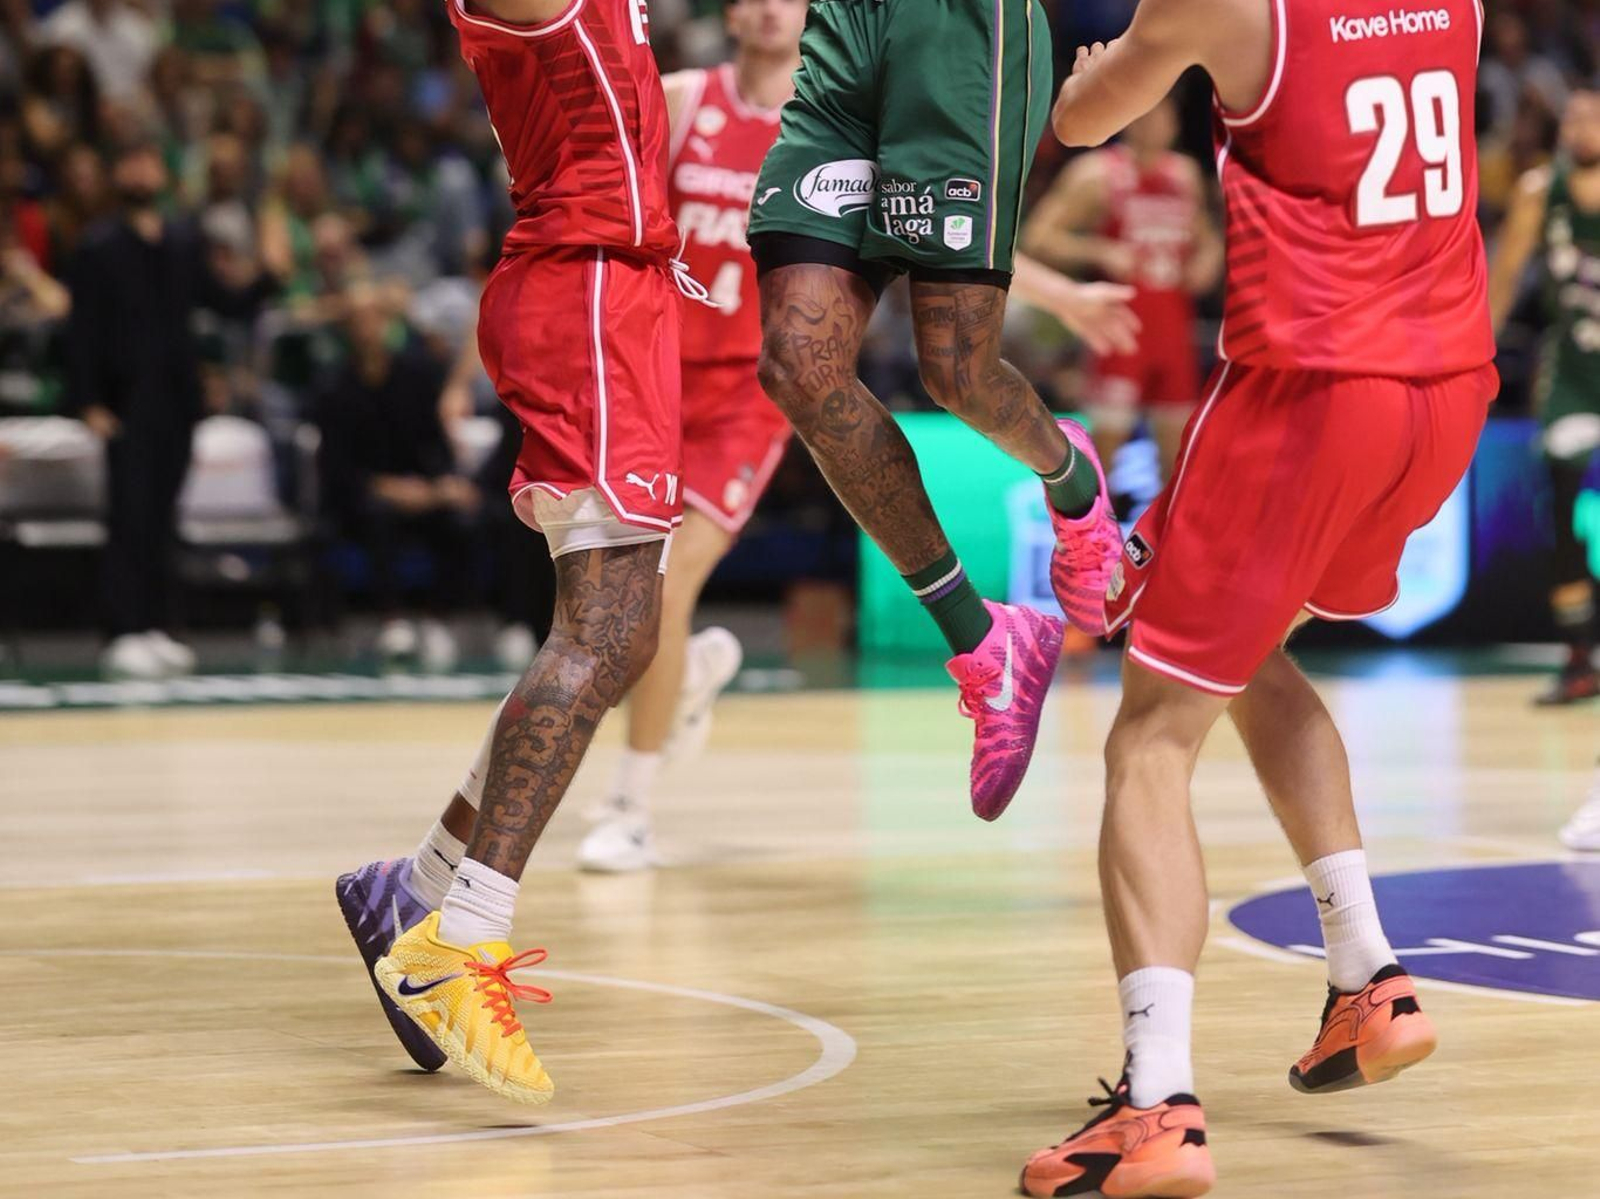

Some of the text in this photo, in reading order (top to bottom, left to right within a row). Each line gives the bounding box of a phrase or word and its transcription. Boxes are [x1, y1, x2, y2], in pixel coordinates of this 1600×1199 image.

[1330, 8, 1450, 43] Kave Home
[1346, 69, 1463, 227] 29
[881, 179, 917, 194] sabor
[881, 186, 935, 215] a má
[948, 187, 972, 197] acb
[882, 212, 934, 244] laga
[1125, 541, 1141, 562] acb
